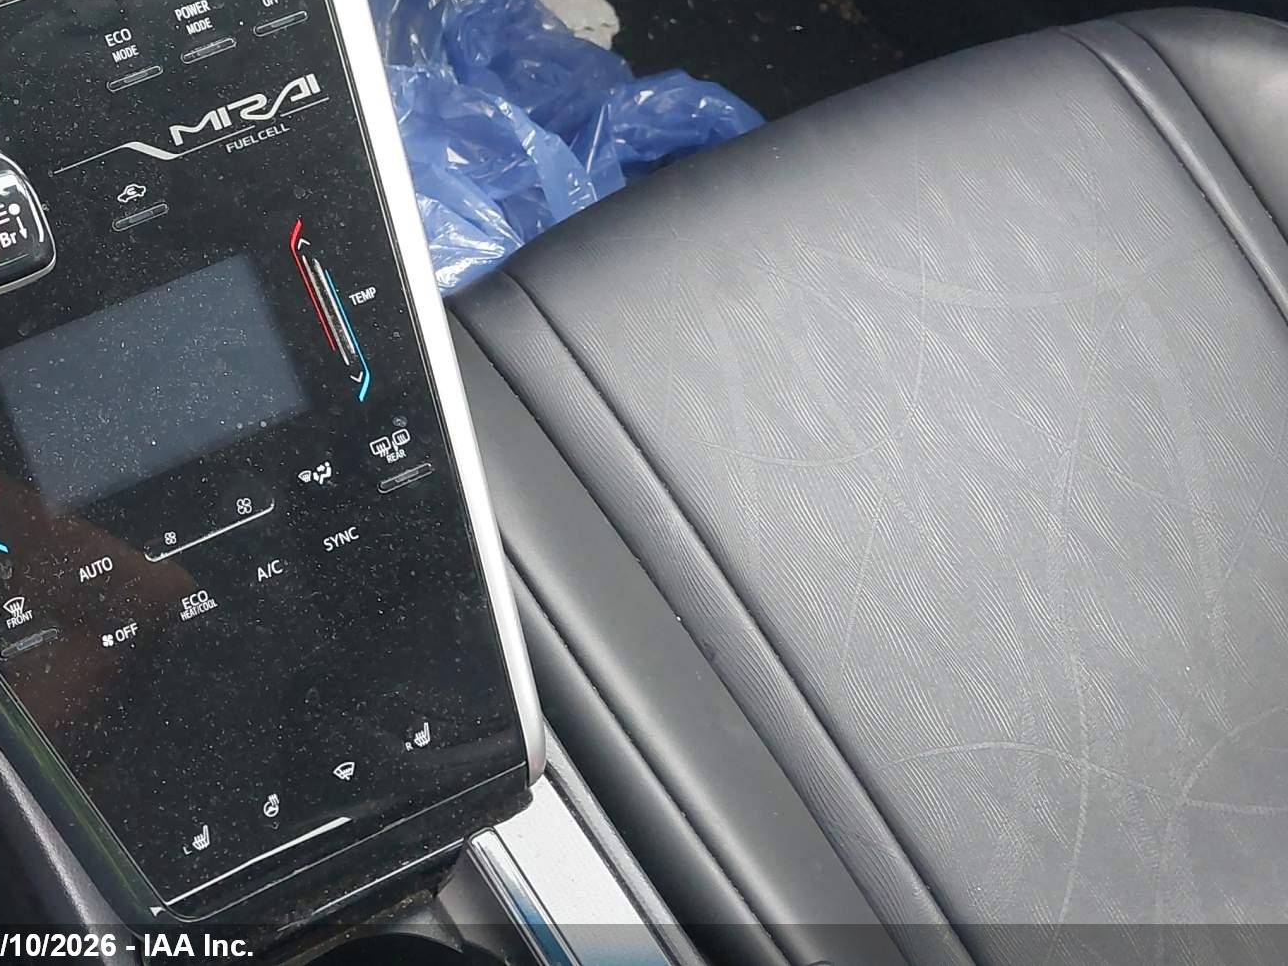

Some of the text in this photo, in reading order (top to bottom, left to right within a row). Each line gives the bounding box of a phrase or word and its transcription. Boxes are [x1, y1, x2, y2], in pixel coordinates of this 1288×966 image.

[174, 0, 211, 22] POWER
[186, 17, 213, 35] MODE
[105, 28, 132, 47] ECO
[112, 44, 140, 63] MODE
[169, 74, 321, 146] MIRAI
[225, 123, 290, 153] FUEL CELL
[349, 287, 377, 307] TEMP
[322, 526, 360, 552] SYNC
[79, 556, 113, 583] AUTO
[257, 559, 283, 582] A/C
[180, 598, 218, 621] HEAT/COOL
[181, 590, 208, 610] ECO
[6, 610, 33, 629] FRONT
[115, 623, 139, 643] OFF
